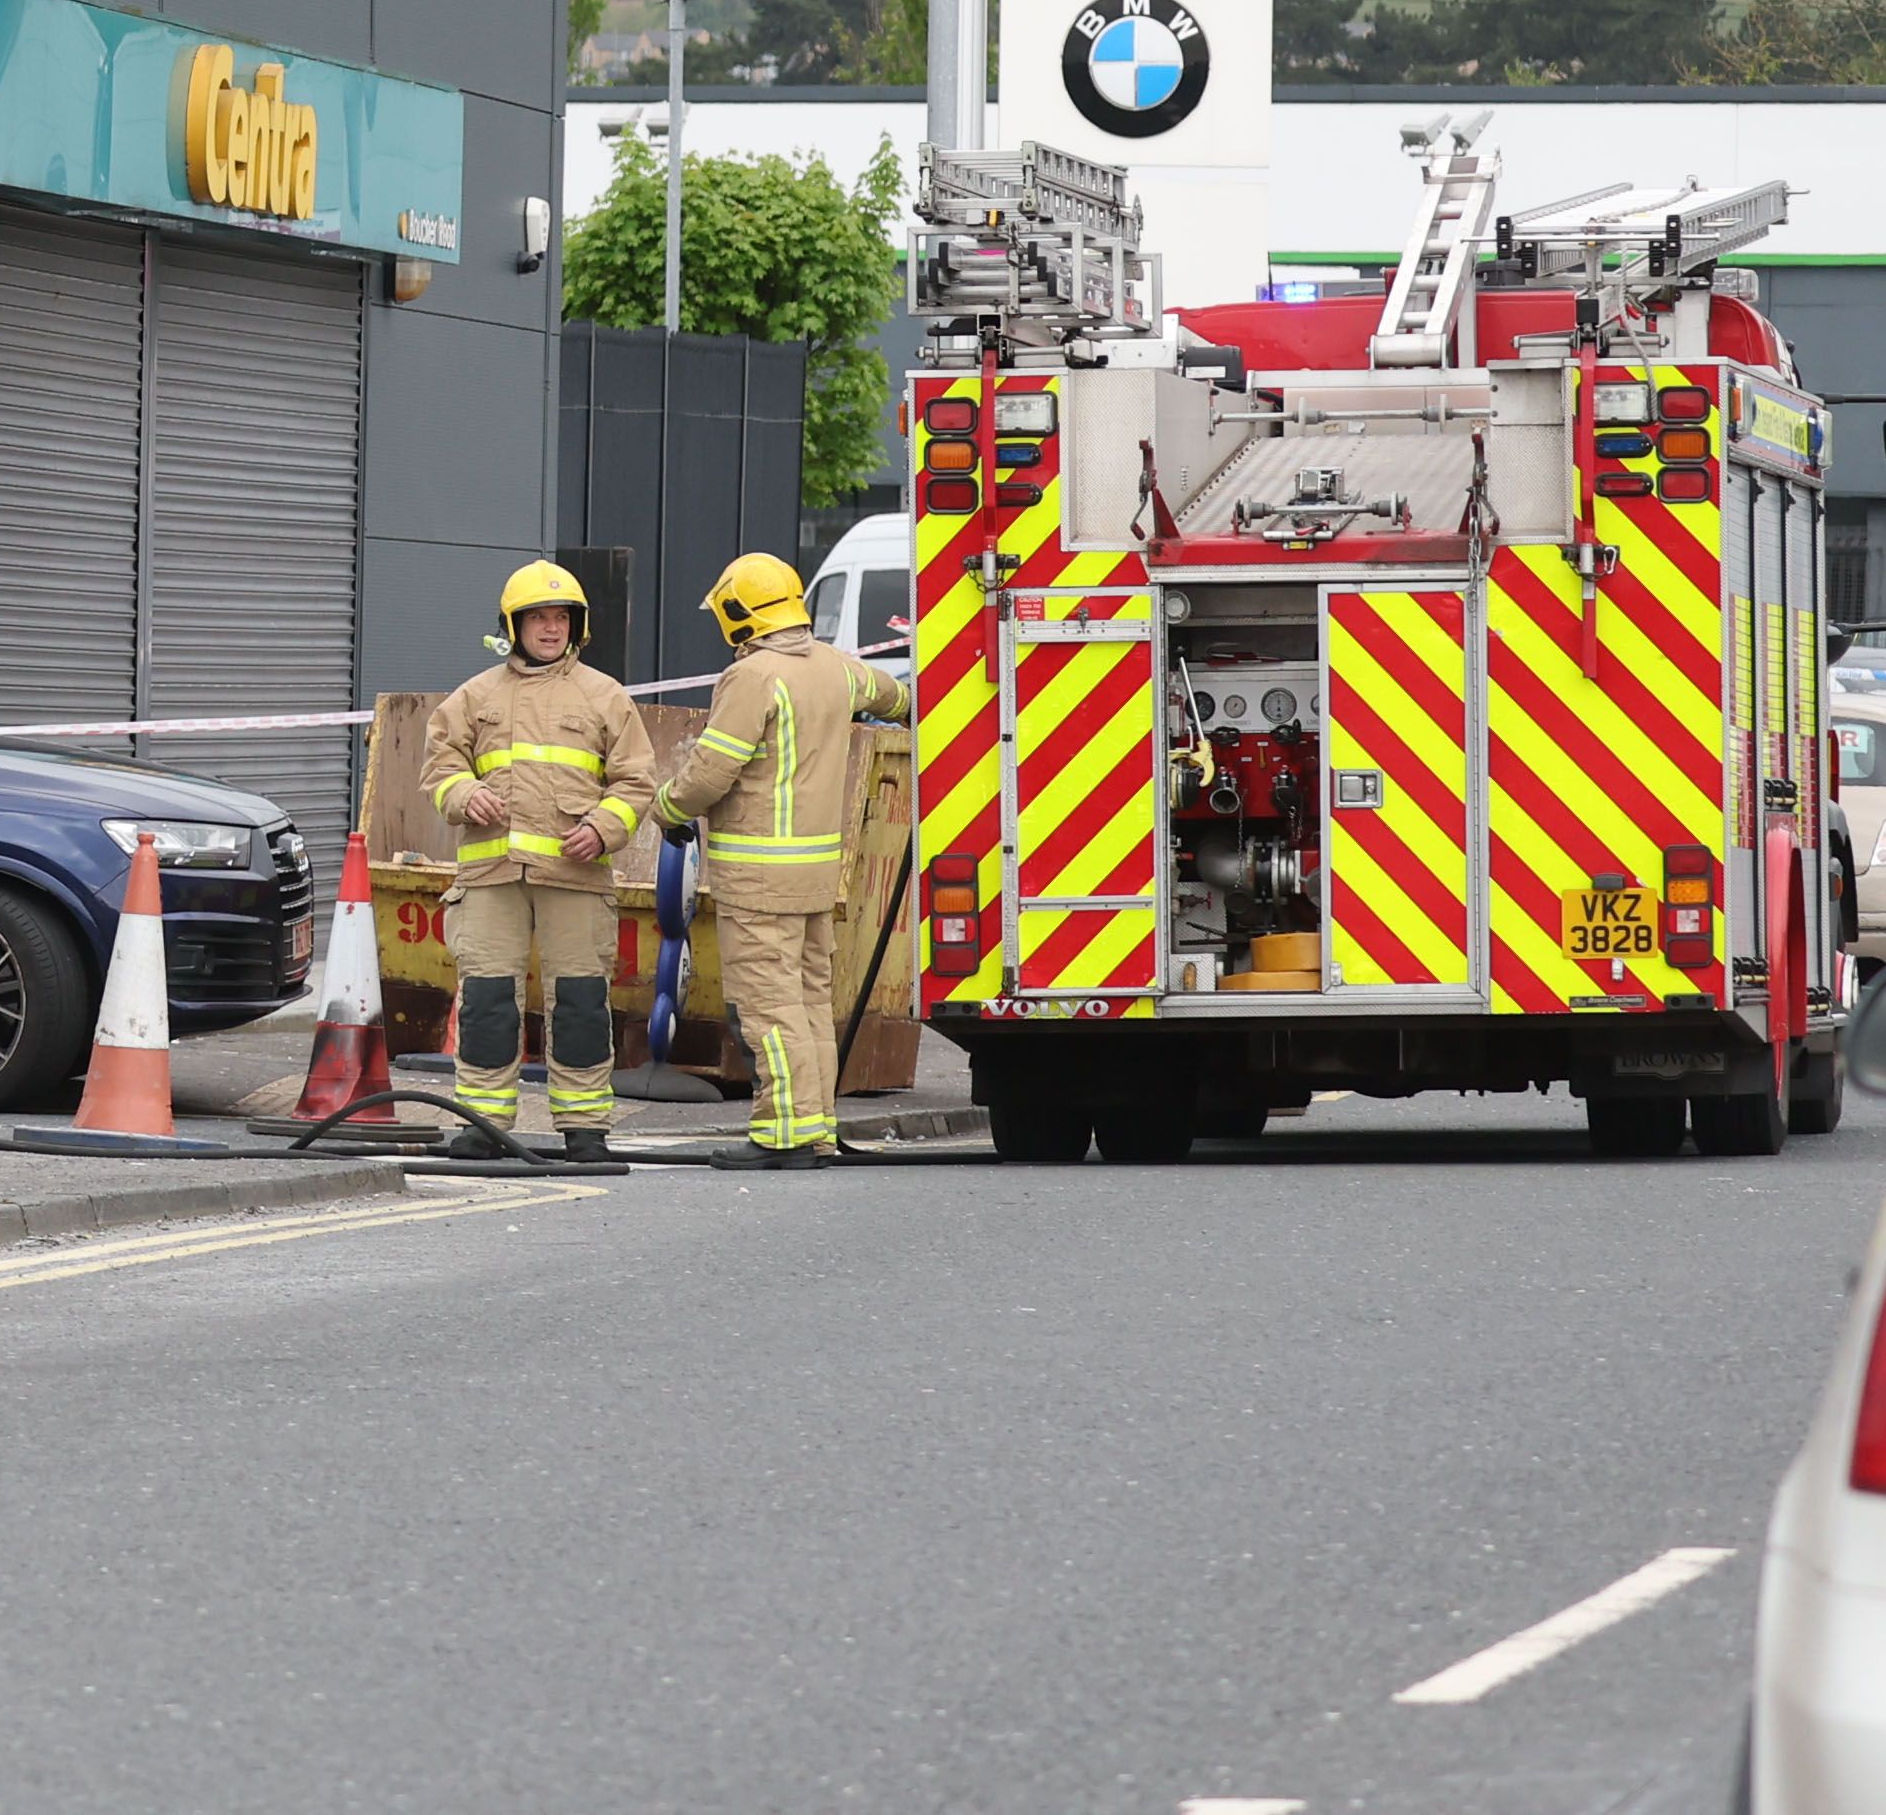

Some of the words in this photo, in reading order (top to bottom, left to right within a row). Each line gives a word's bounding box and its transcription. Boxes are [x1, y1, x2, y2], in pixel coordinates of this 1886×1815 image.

[187, 44, 317, 220] Centra
[1840, 730, 1859, 746] R
[1581, 894, 1642, 922] VKZ
[1570, 925, 1653, 954] 3828
[982, 999, 1109, 1016] VOLVO
[1622, 1052, 1721, 1067] BROWNS
